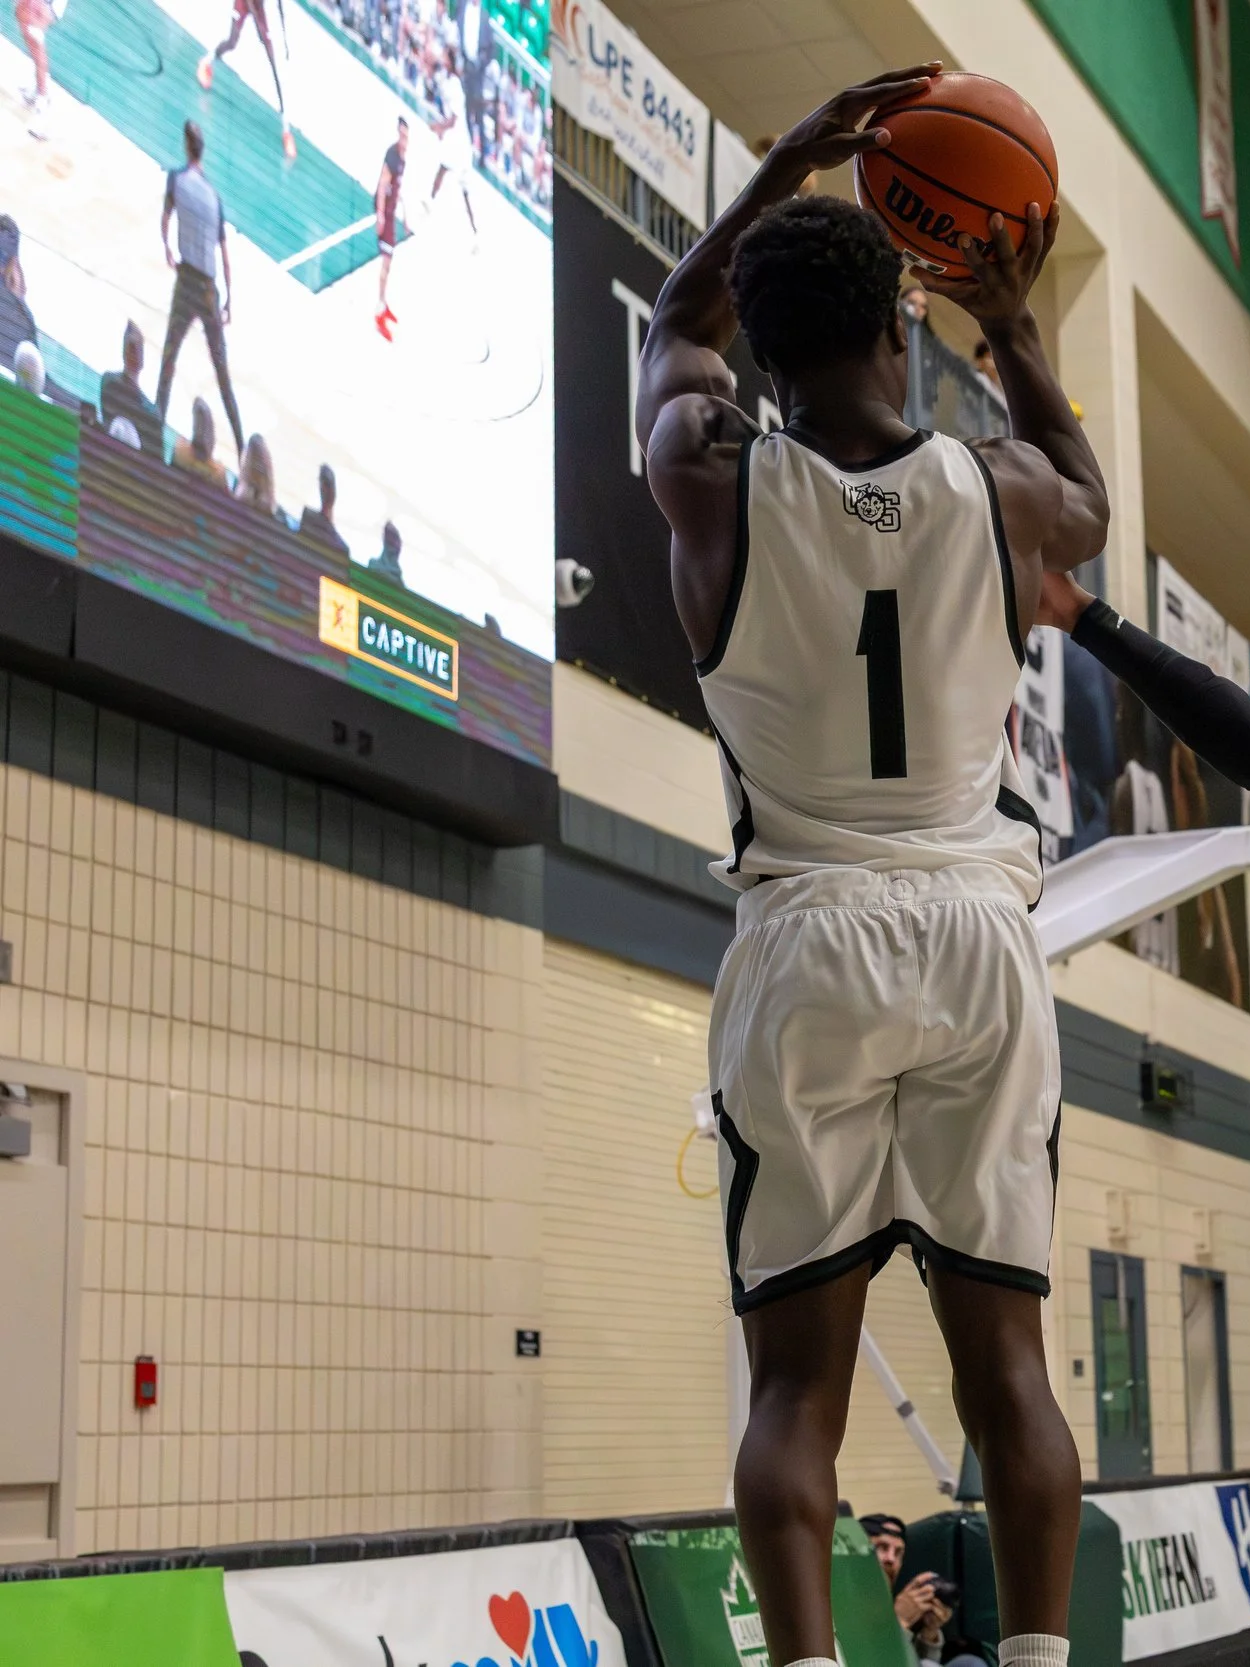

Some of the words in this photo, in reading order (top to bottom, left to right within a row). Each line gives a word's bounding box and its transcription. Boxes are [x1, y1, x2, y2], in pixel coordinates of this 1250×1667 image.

[643, 77, 696, 157] 8443
[362, 615, 450, 681] CAPTIVE
[856, 588, 908, 780] 1
